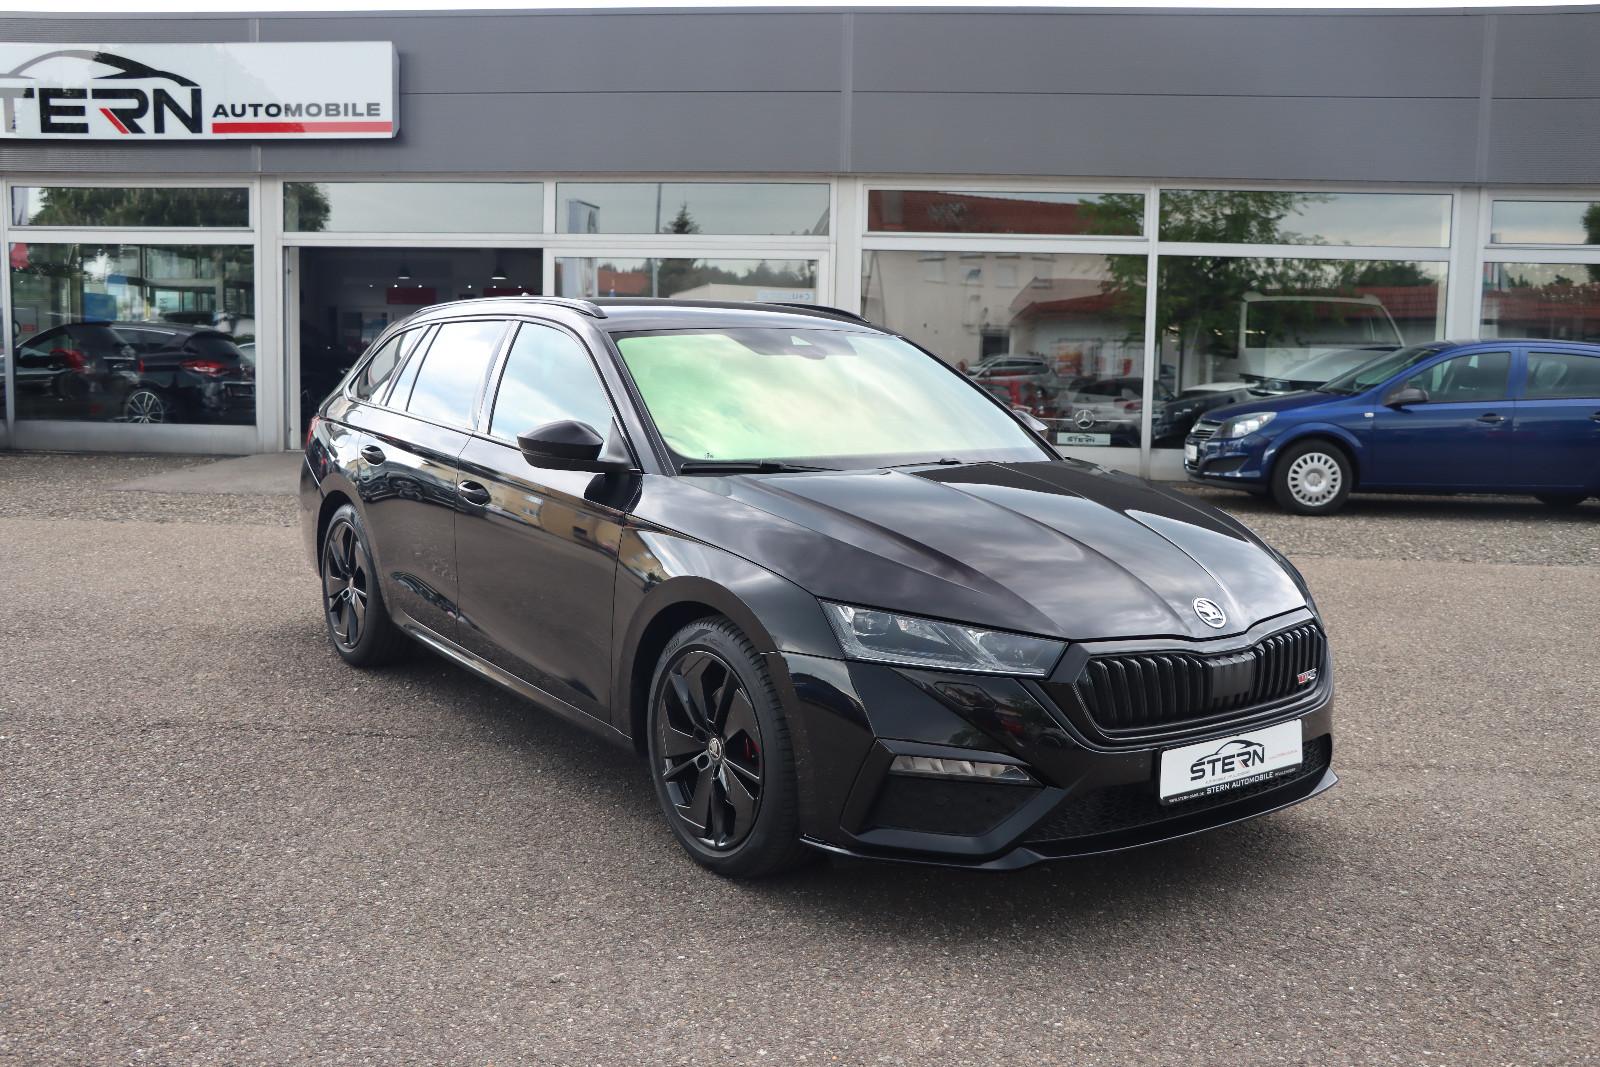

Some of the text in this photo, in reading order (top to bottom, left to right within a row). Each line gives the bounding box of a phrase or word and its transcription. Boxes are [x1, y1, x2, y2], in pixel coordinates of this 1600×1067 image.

[212, 103, 381, 118] AUTOMOBILE
[1190, 747, 1265, 782] STERN
[1206, 782, 1230, 795] STERN
[1231, 771, 1274, 788] AUTOMOBILE
